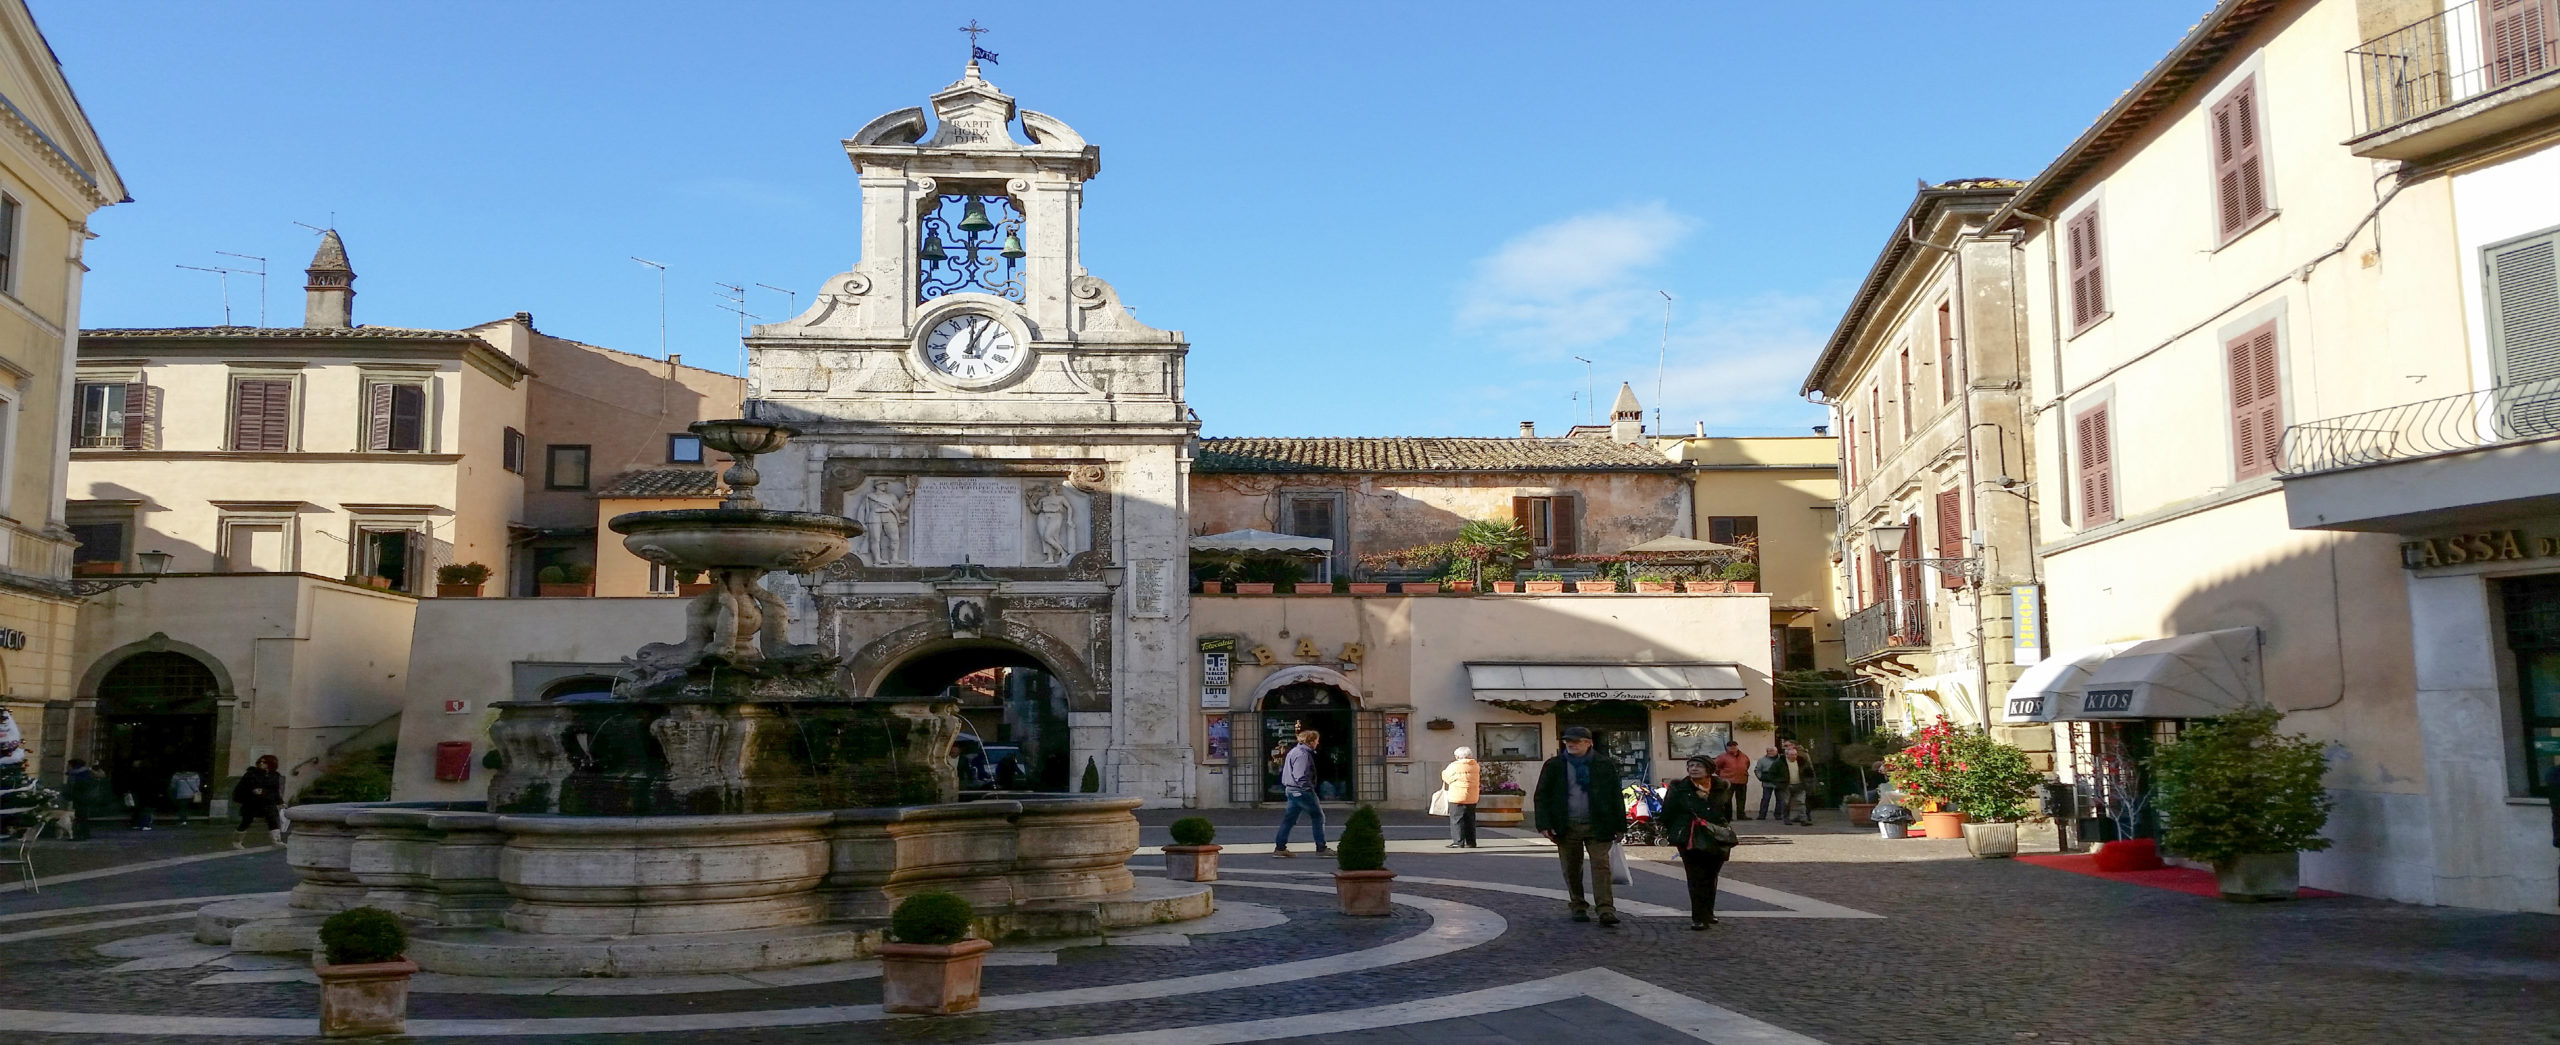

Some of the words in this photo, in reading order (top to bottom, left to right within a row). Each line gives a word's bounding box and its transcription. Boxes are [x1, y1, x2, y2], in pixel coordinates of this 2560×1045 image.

[954, 120, 992, 128] RAPIT
[954, 128, 990, 136] HORA
[955, 135, 989, 144] DIEM
[2402, 531, 2522, 567] ASSA
[1251, 638, 1363, 666] BAR
[2010, 701, 2044, 715] KIOS
[2088, 694, 2129, 709] KIOS
